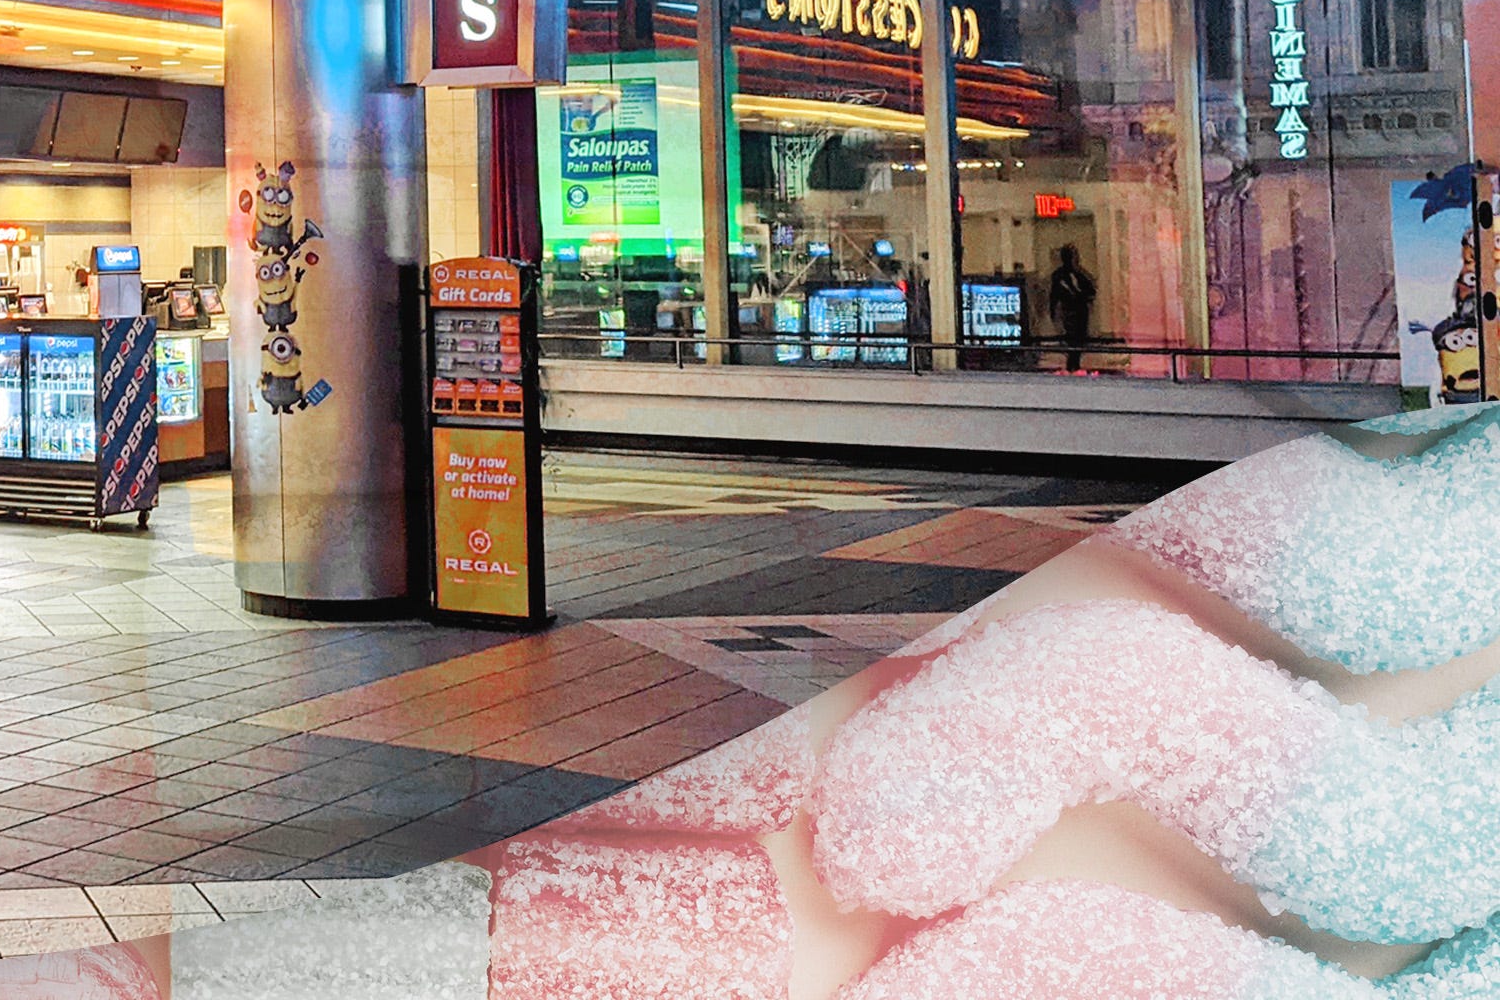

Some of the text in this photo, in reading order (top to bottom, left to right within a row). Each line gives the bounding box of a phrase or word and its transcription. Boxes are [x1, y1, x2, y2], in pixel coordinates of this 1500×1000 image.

[567, 137, 649, 160] Salonpas
[566, 160, 590, 173] Pain
[623, 159, 653, 173] Patch
[114, 248, 133, 263] pepsi
[455, 269, 515, 281] REGAL
[439, 287, 512, 303] Gift Cards
[56, 339, 78, 348] pepsi
[105, 377, 141, 441] PEPSI
[120, 401, 156, 466] PEPSI
[449, 453, 507, 469] Buy now
[444, 471, 517, 485] or activate
[451, 485, 511, 501] at home!
[445, 558, 519, 575] REGAL
